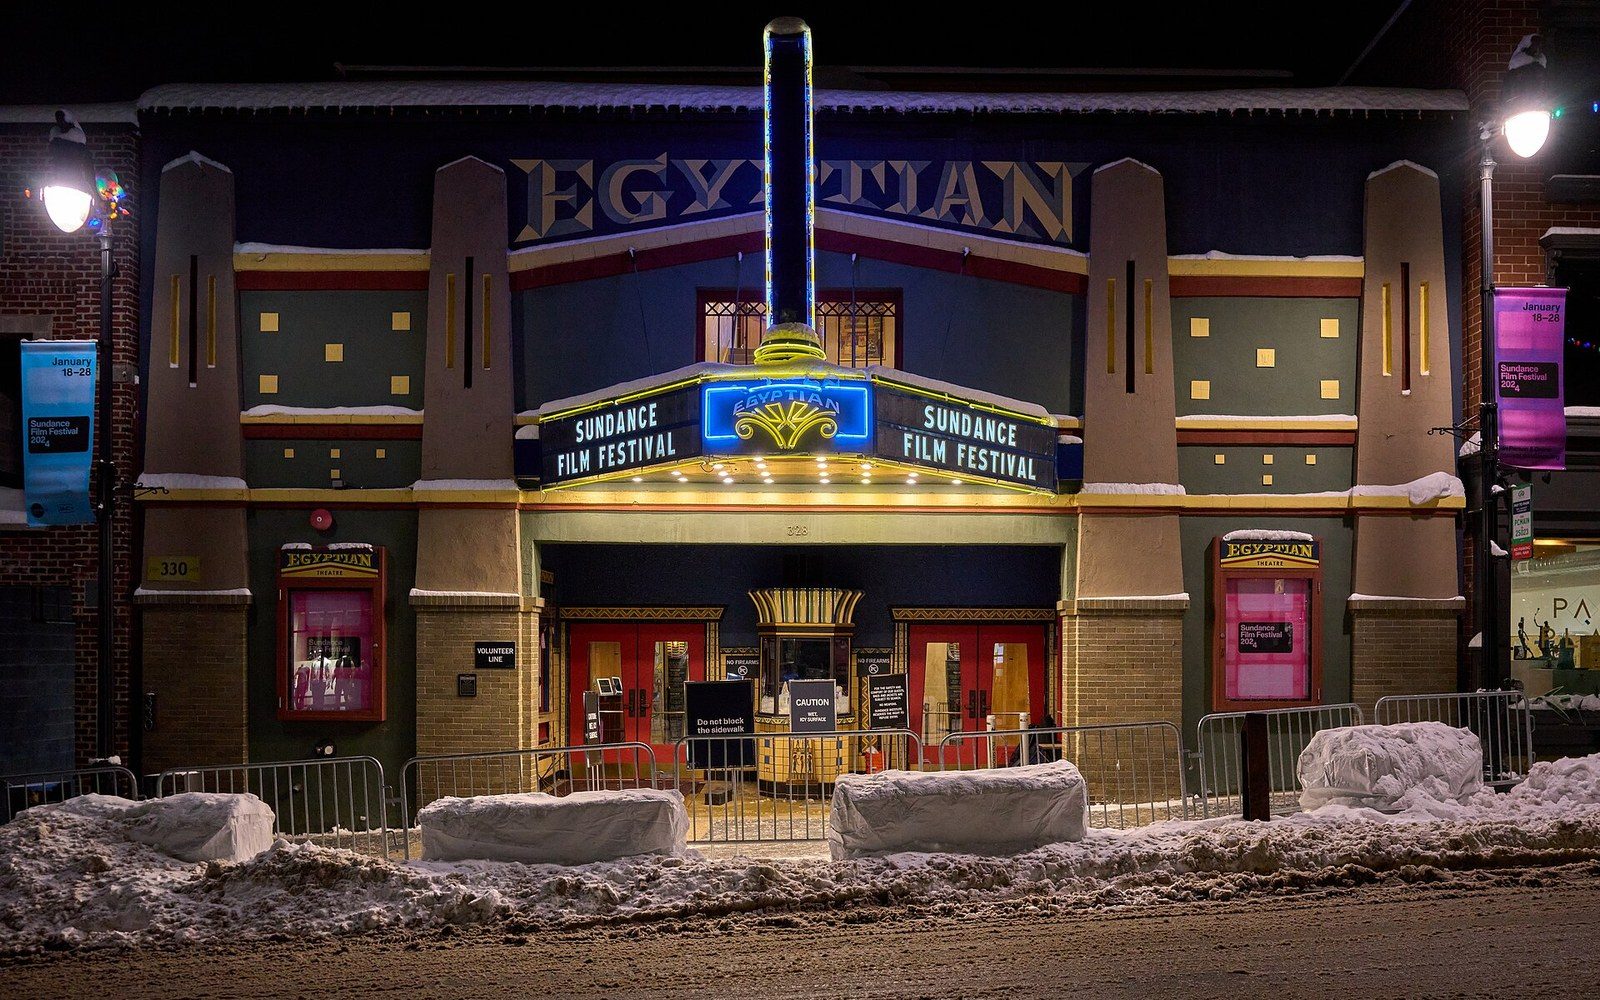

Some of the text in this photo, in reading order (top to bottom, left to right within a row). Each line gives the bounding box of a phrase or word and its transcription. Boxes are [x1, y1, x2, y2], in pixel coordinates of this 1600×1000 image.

[508, 152, 1094, 243] EGYTIAN
[1522, 302, 1561, 314] January
[52, 357, 92, 367] January
[1500, 364, 1539, 373] Sundance
[1500, 373, 1547, 381] Film Festival
[1500, 381, 1520, 392] 2024
[733, 389, 840, 415] EGYPTIAN
[575, 402, 657, 443] SUNDANCE
[923, 404, 1018, 448] SUNDANCE
[48, 427, 78, 435] Festival
[30, 436, 50, 447] 2024
[557, 431, 676, 477] FILM FESTIVAL
[903, 432, 1037, 481] FILM FESTIVAL
[787, 525, 808, 537] 328
[1227, 543, 1314, 558] EGYPTIAN
[287, 553, 372, 567] EGYPTIAN
[160, 562, 188, 576] 330
[1240, 624, 1275, 632] Sundance
[1240, 638, 1258, 648] 2024
